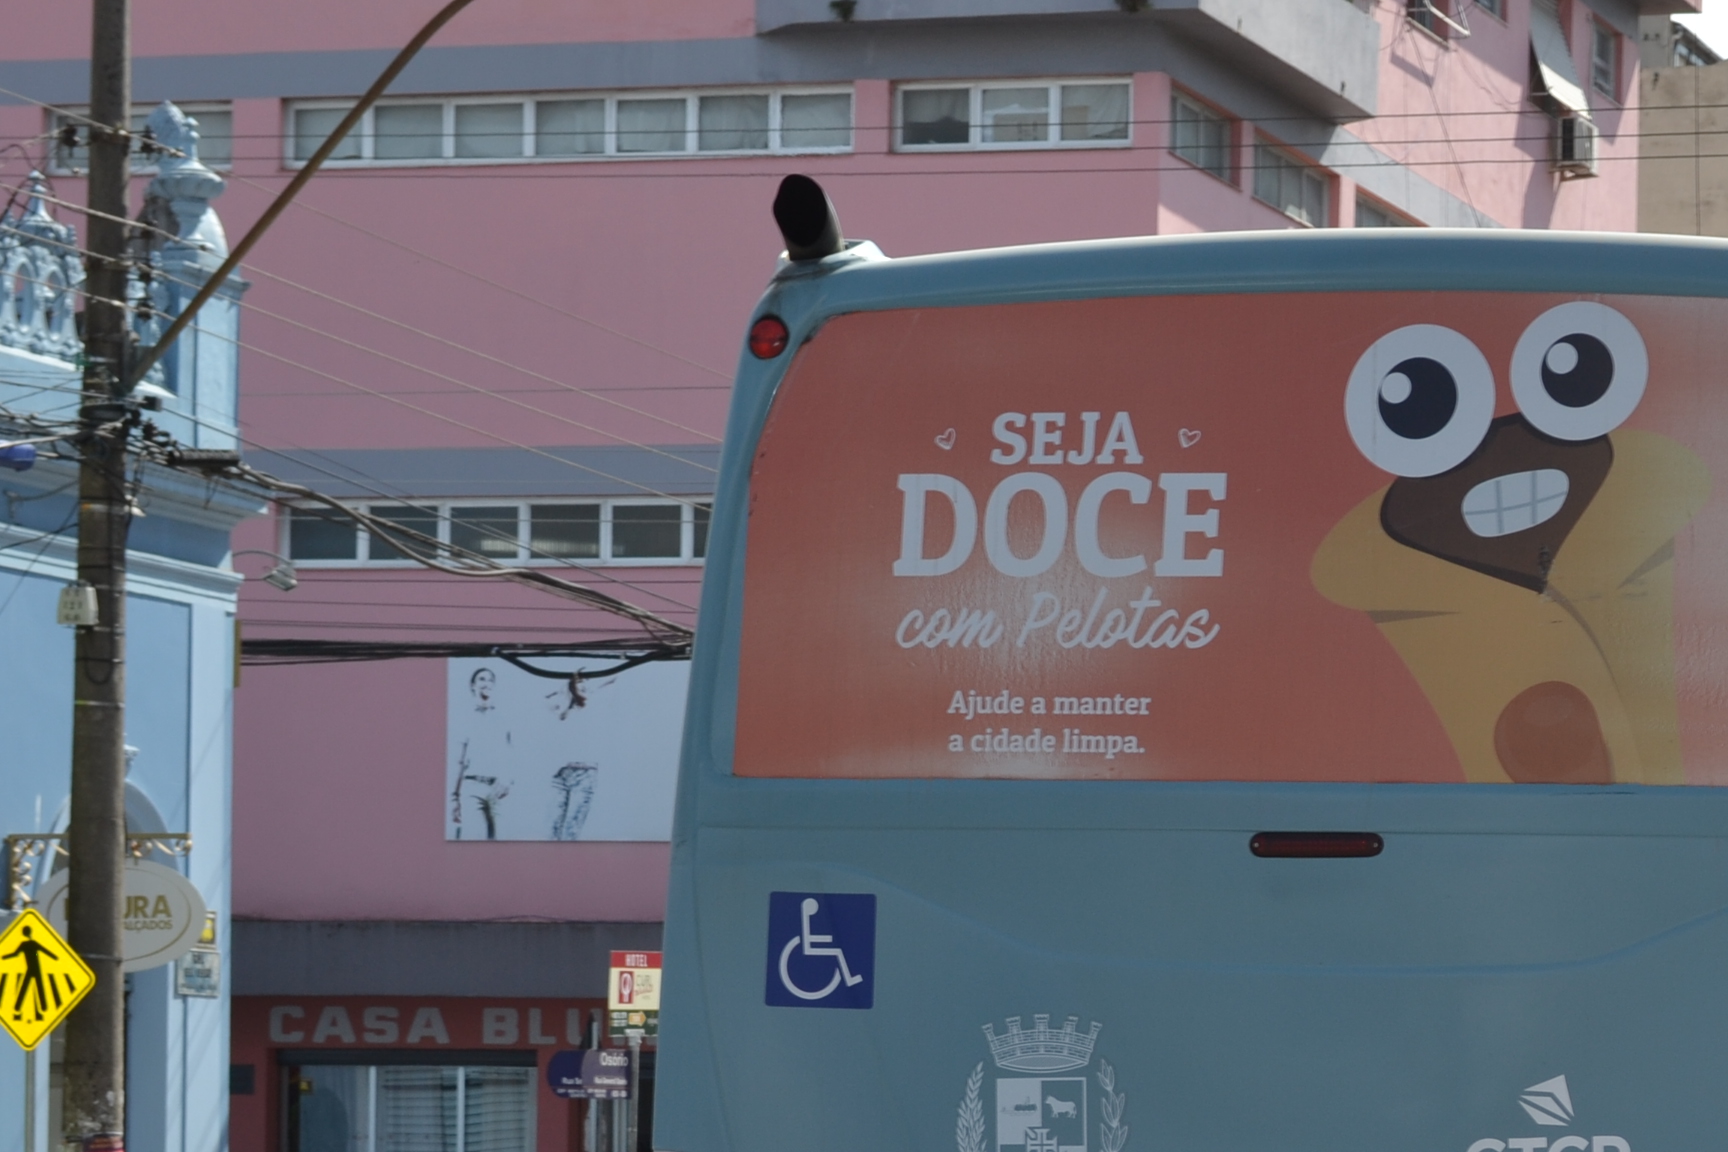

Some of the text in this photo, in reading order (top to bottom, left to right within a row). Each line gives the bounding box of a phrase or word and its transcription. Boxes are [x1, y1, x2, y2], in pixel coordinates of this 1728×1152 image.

[990, 411, 1144, 465] SEJA
[892, 472, 1228, 578] DOCE
[896, 584, 1220, 650] com Pelotas
[947, 689, 1152, 721] Ajude a manter
[948, 728, 1146, 758] a cidade limpa.
[625, 953, 648, 967] HOTEL
[269, 1005, 450, 1044] CASA
[600, 1051, 628, 1066] Osório
